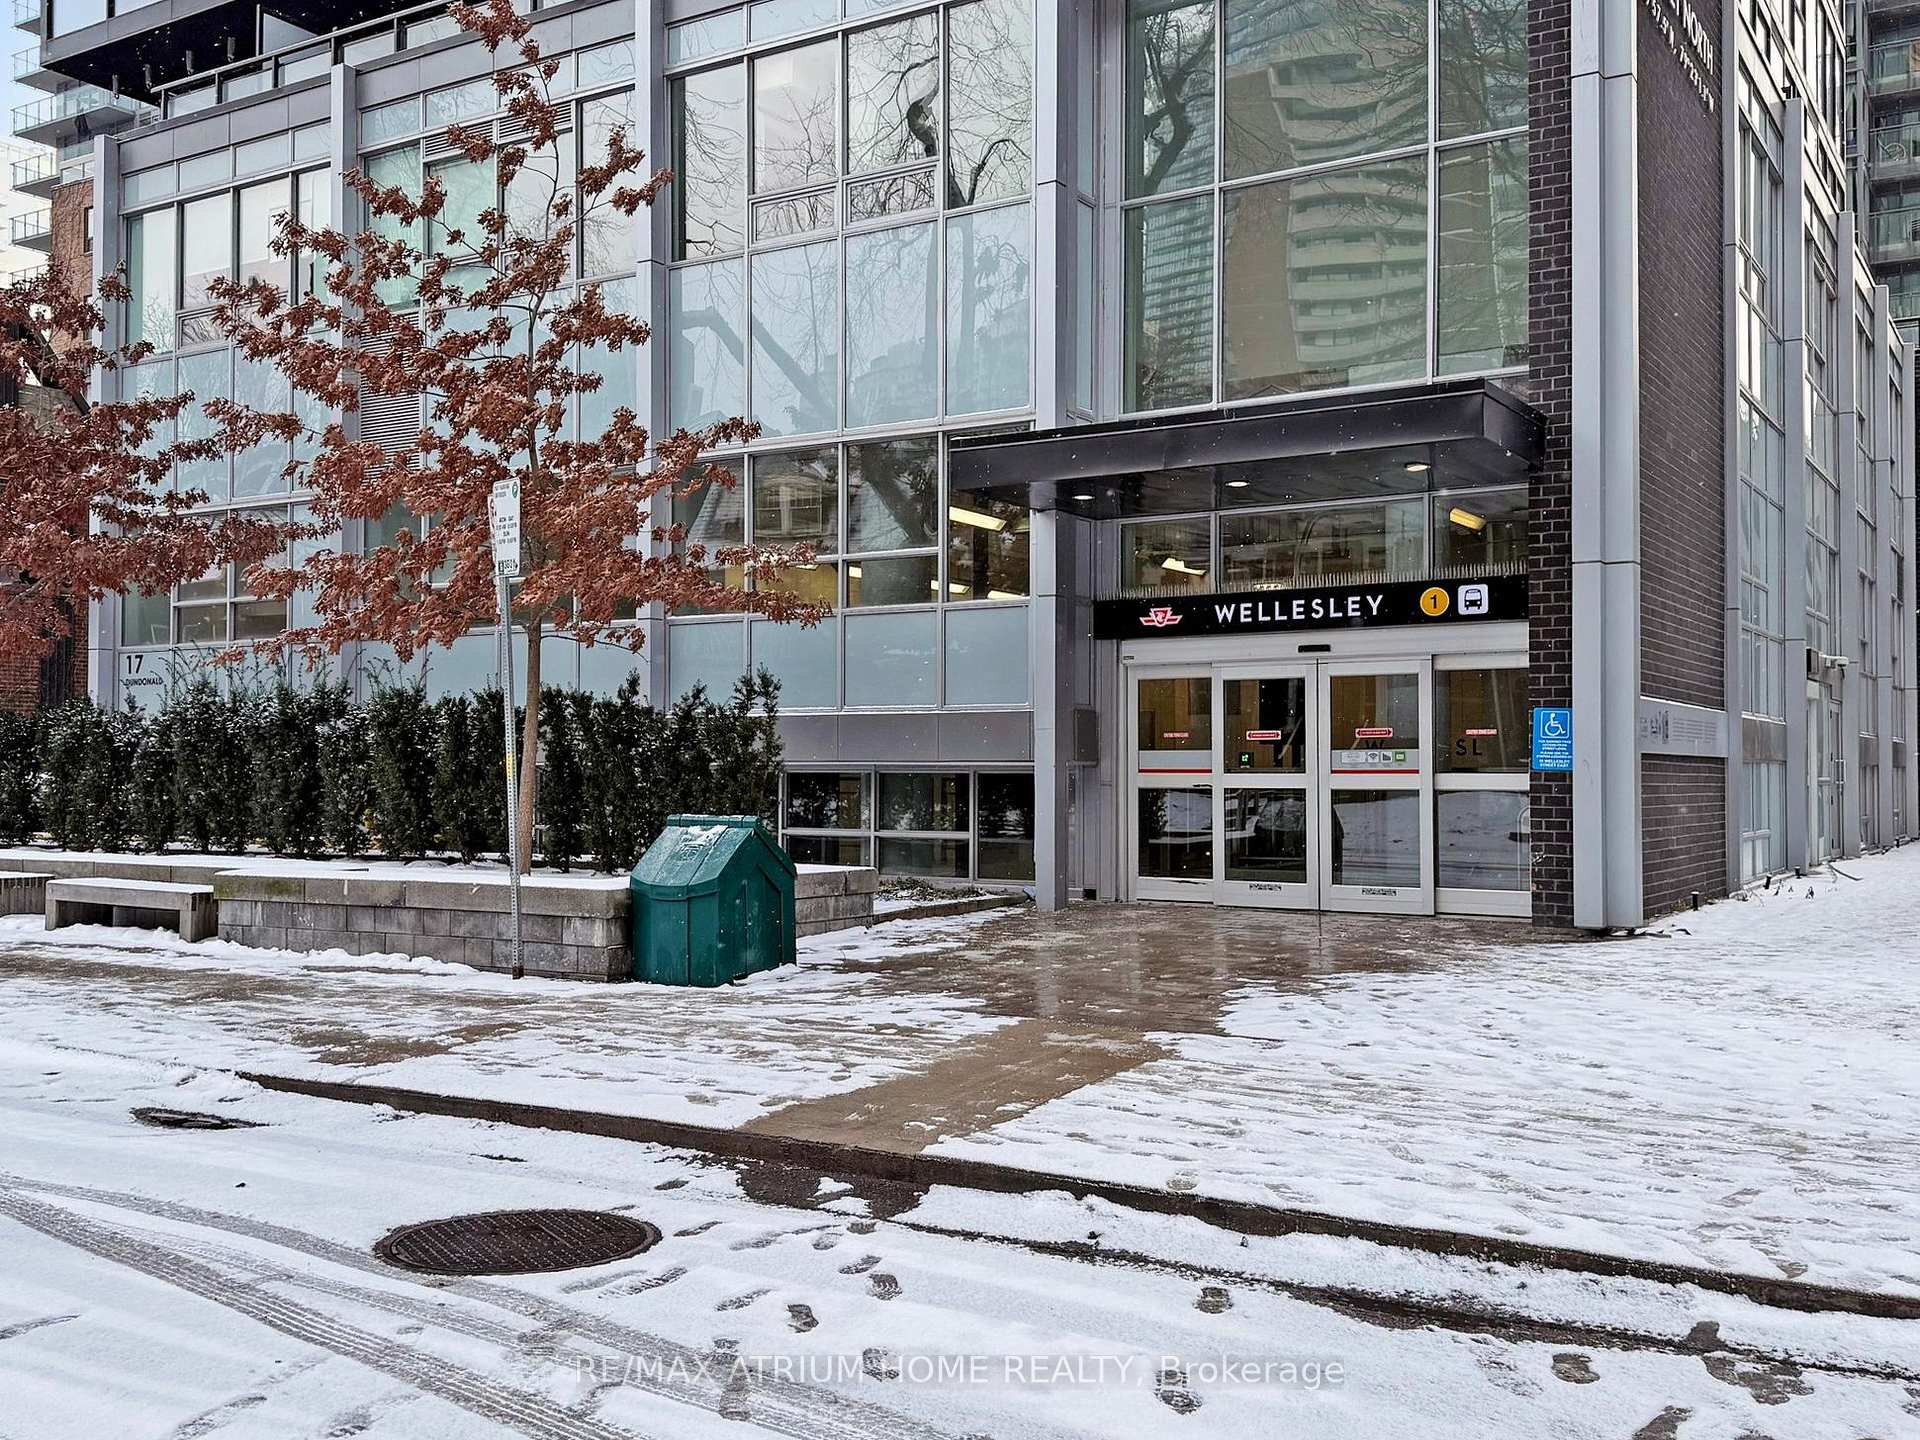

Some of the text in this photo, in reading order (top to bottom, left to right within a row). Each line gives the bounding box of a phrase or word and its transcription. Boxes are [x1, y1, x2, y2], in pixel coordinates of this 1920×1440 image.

[1683, 0, 1713, 75] NORTH
[1214, 594, 1384, 623] WELLESLEY
[126, 655, 144, 674] 17
[125, 678, 164, 687] DUNDONALD
